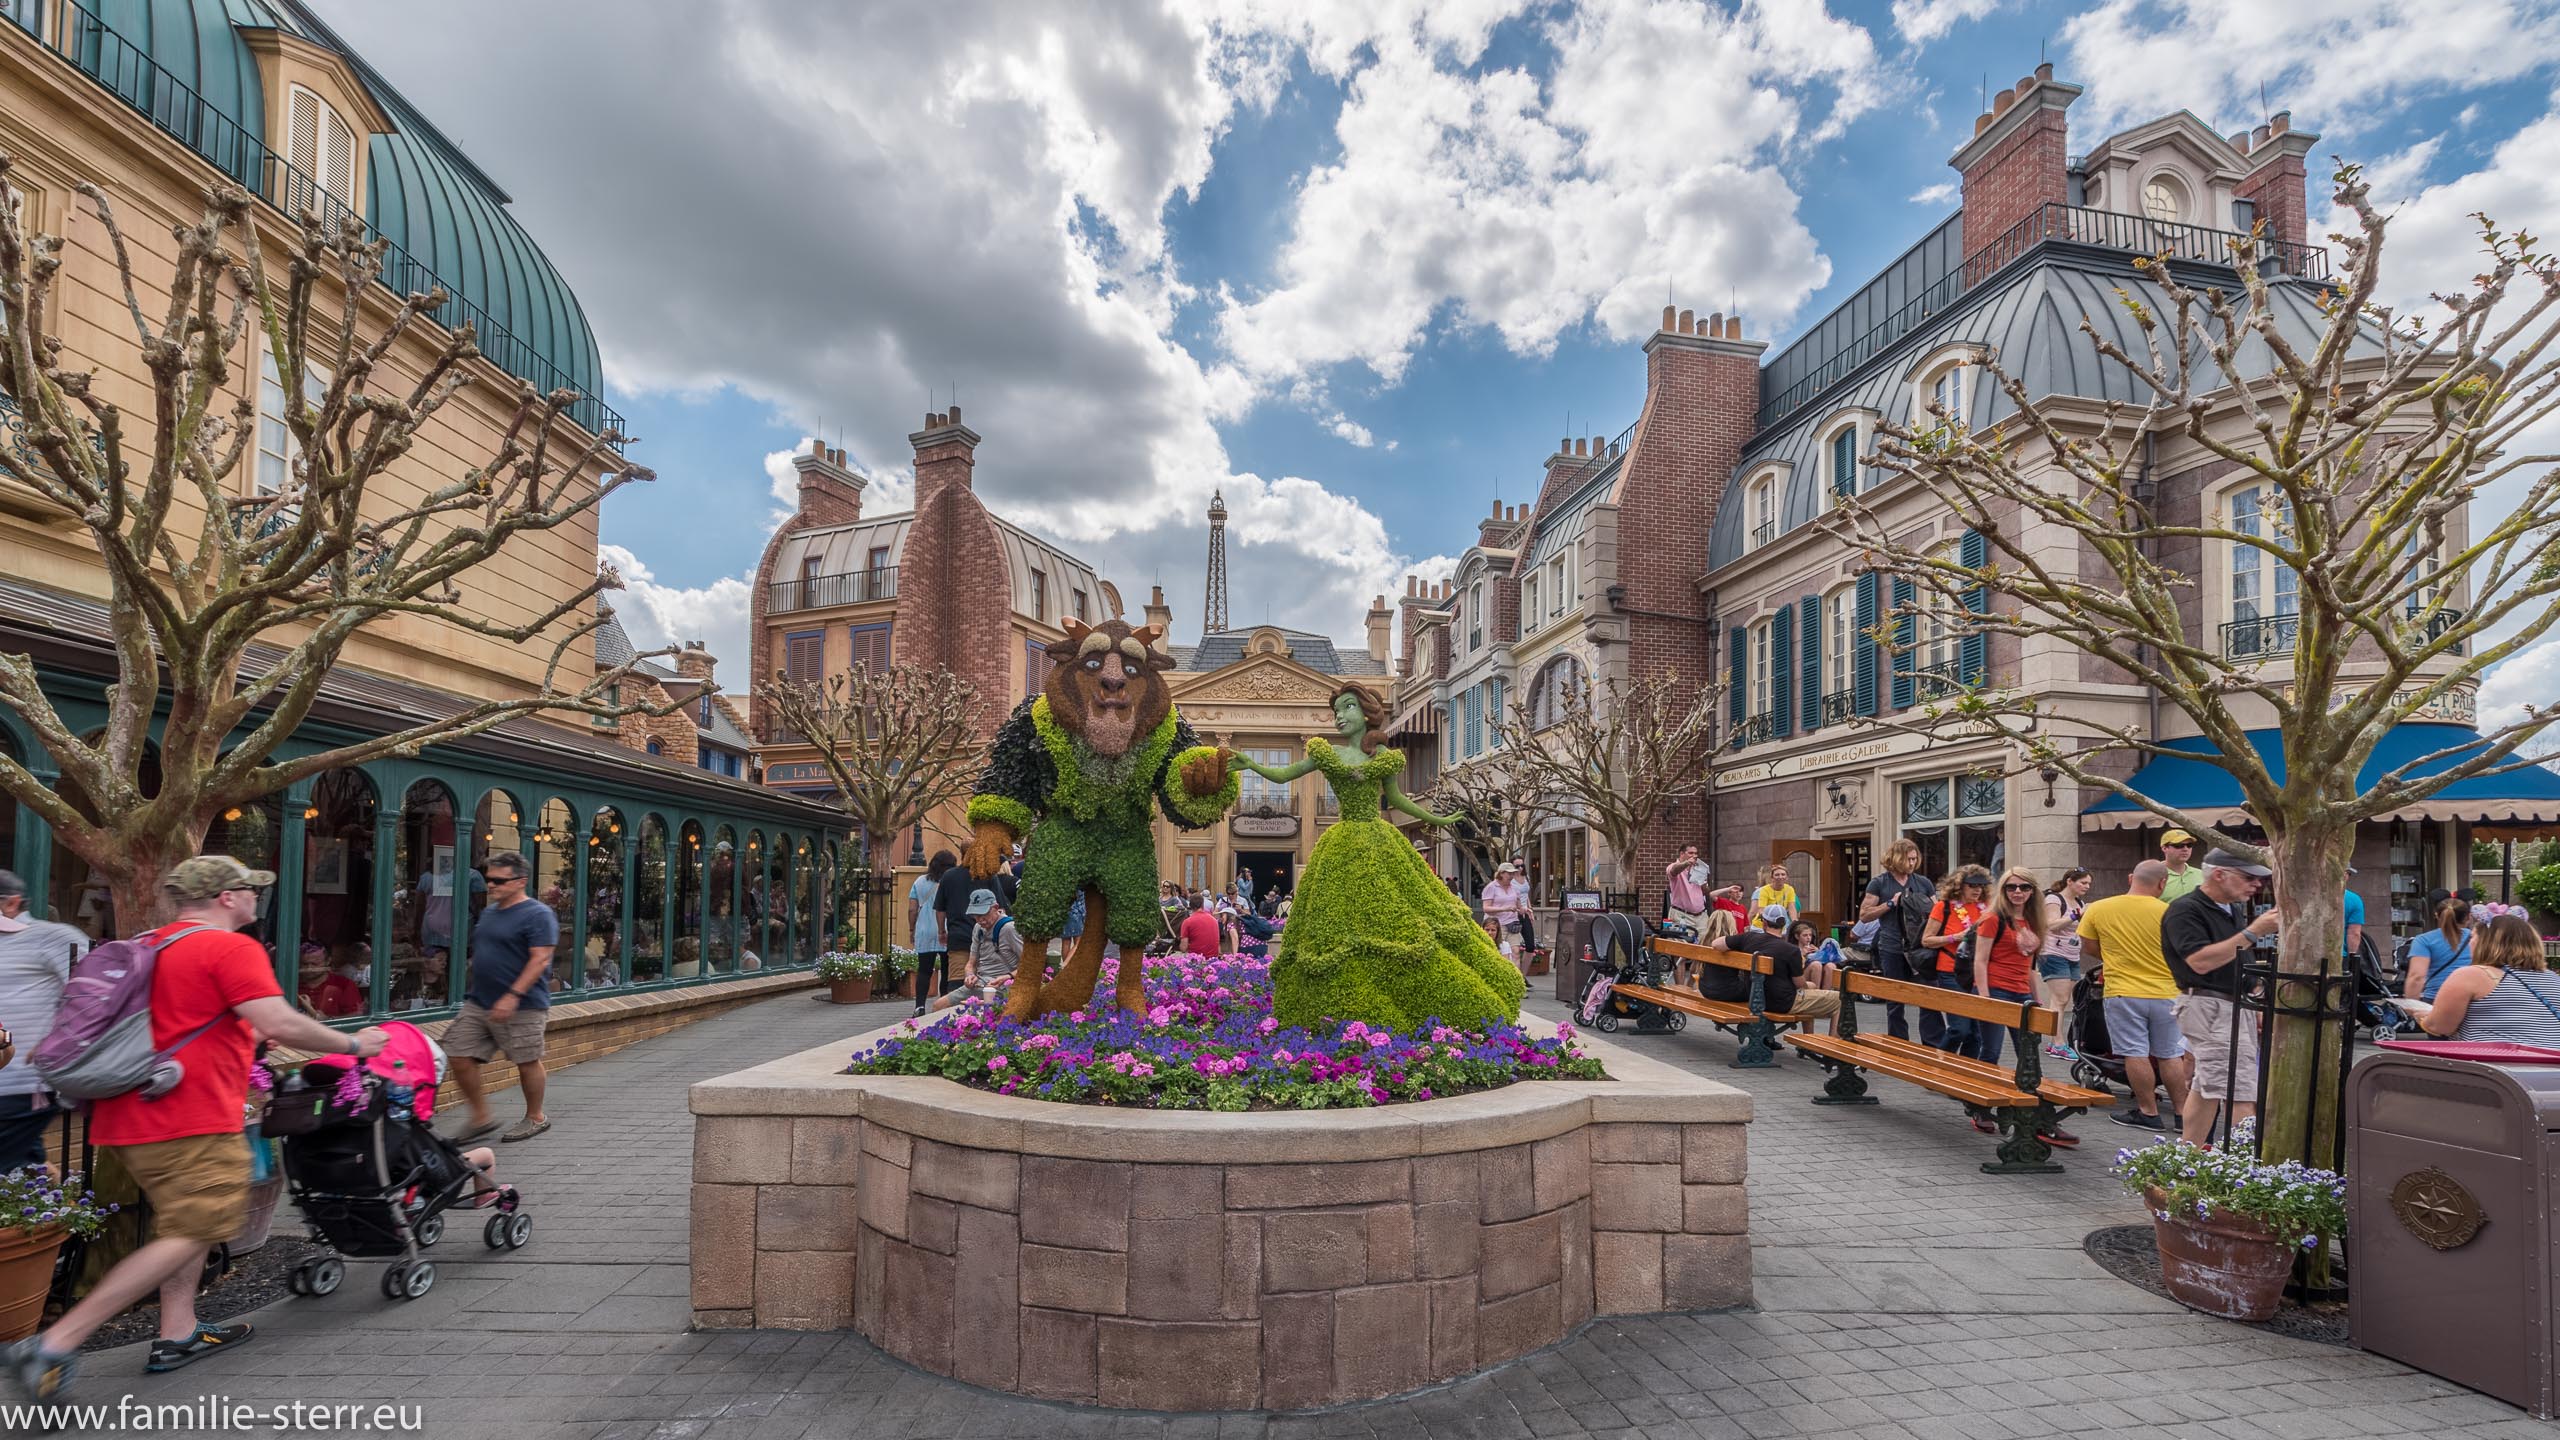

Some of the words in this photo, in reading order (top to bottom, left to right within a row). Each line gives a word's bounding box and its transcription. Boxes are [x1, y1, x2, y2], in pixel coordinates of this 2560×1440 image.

[1799, 751, 1840, 770] LIBRAIRIE
[1849, 742, 1890, 761] GALERIE
[794, 767, 805, 778] La
[1723, 768, 1762, 784] BEAUX-ARTS
[1244, 819, 1287, 827] IMPRESSIONS
